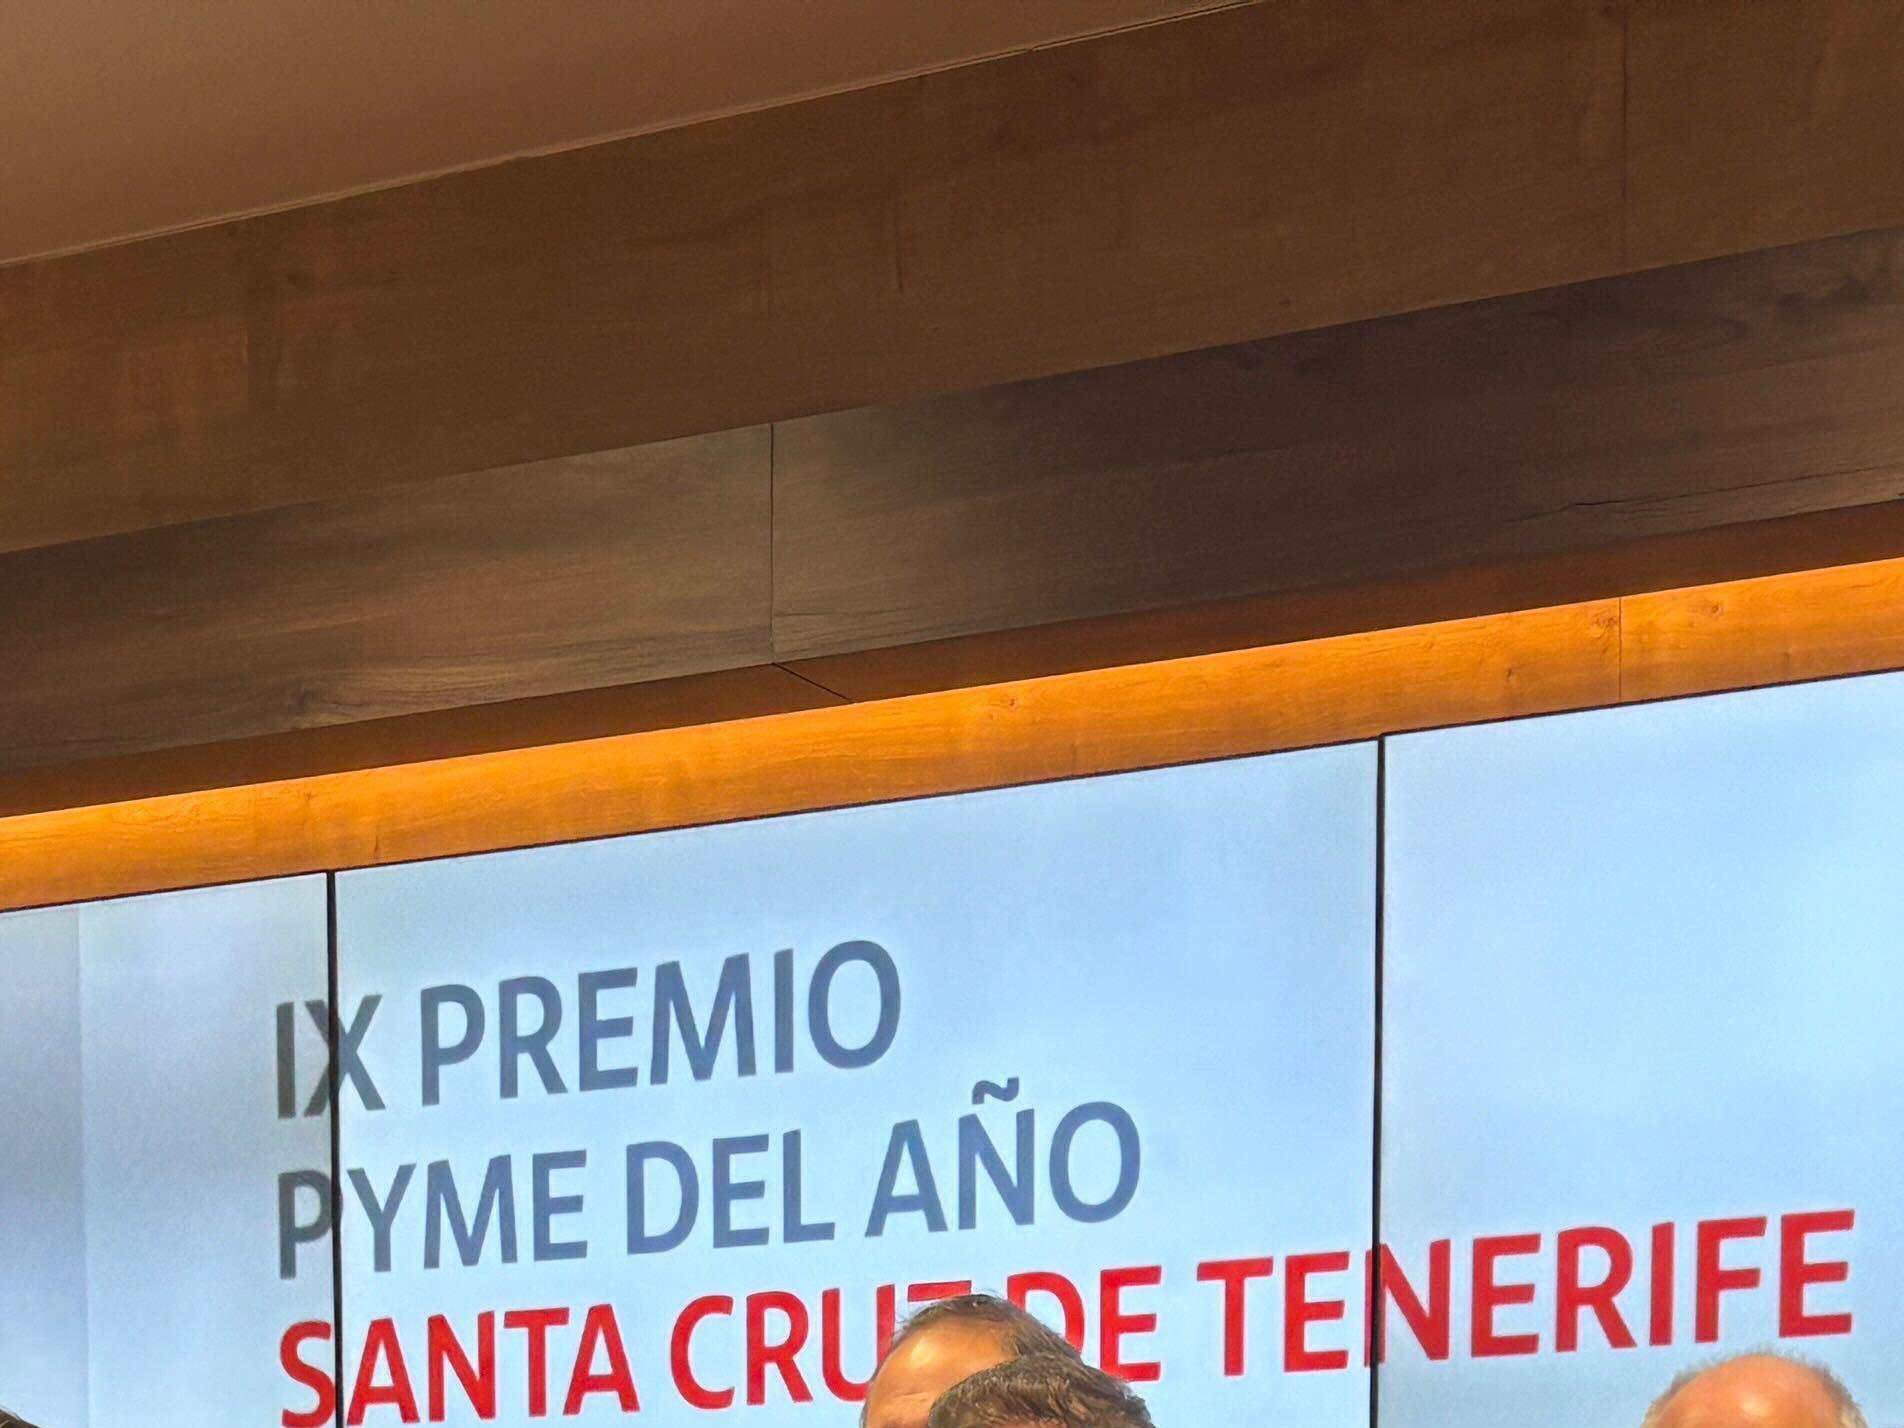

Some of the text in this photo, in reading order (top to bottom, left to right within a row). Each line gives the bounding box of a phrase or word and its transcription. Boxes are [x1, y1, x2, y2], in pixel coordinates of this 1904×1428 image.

[275, 940, 901, 1120] IX PREMIO
[277, 1076, 1142, 1280] PYME DEL AÑO
[669, 1279, 972, 1410] CRU
[1197, 1209, 1855, 1376] TENERIFE
